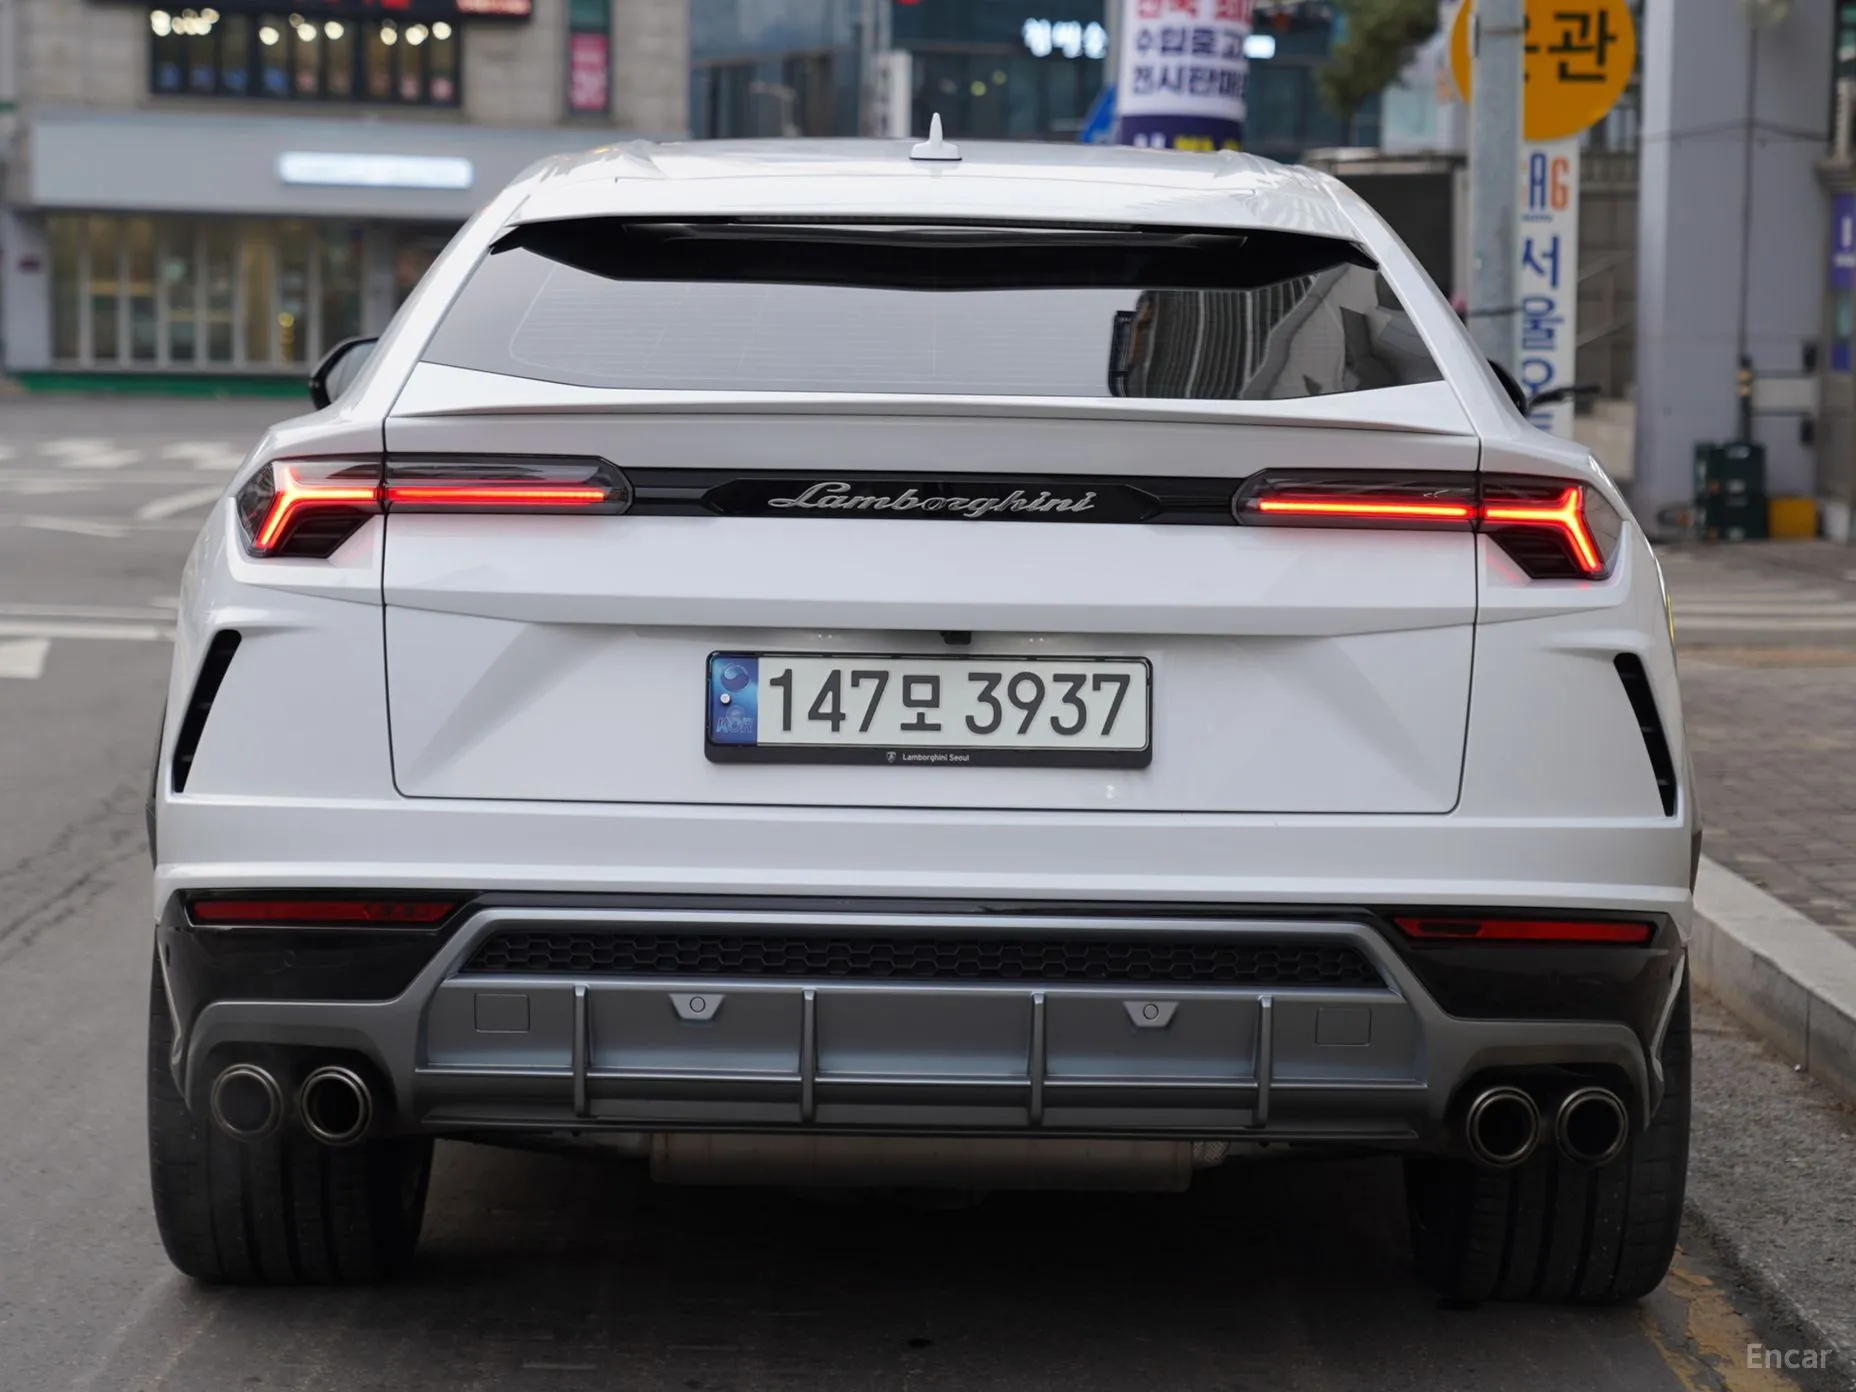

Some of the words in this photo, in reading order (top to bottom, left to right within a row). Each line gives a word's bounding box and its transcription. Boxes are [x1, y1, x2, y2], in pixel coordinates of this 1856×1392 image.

[768, 481, 1097, 518] Lamborghini
[769, 668, 942, 732] 147모
[965, 671, 1131, 736] 3937
[902, 752, 948, 763] Lamborghini
[949, 753, 970, 762] Seoul
